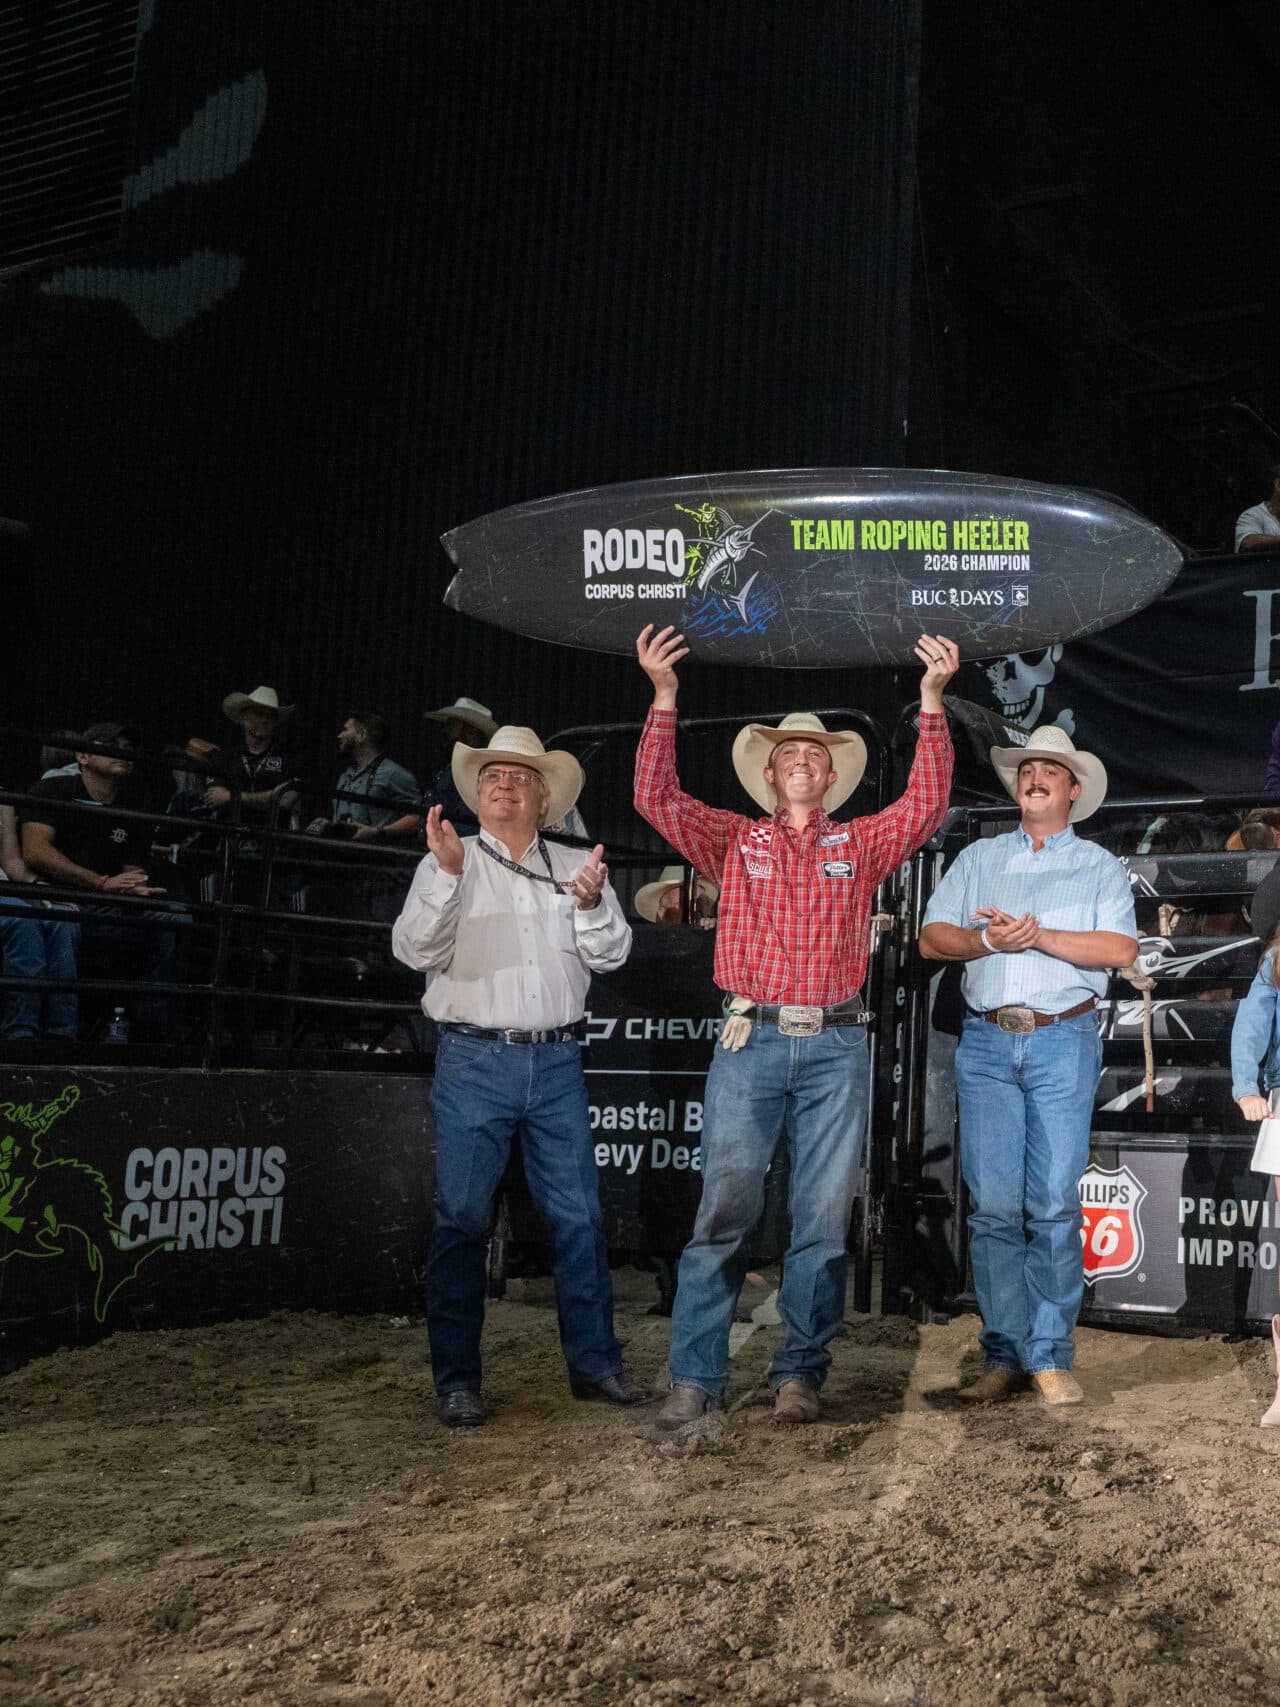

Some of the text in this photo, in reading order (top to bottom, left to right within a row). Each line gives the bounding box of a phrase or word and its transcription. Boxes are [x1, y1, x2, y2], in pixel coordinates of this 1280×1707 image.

[791, 519, 1030, 551] TEAM ROPING HEELER
[583, 528, 685, 579] RODEO
[924, 554, 1030, 572] 2026 CHAMPION
[584, 583, 687, 600] CORPUS CHRISTI
[911, 589, 947, 606] BUC
[960, 590, 1004, 606] DAYS
[588, 1099, 675, 1132] oastal
[124, 1145, 287, 1202] CORPUS
[594, 1142, 645, 1175] evy
[1081, 1184, 1130, 1204] ILLIPS
[120, 1196, 284, 1252] CHRISTI
